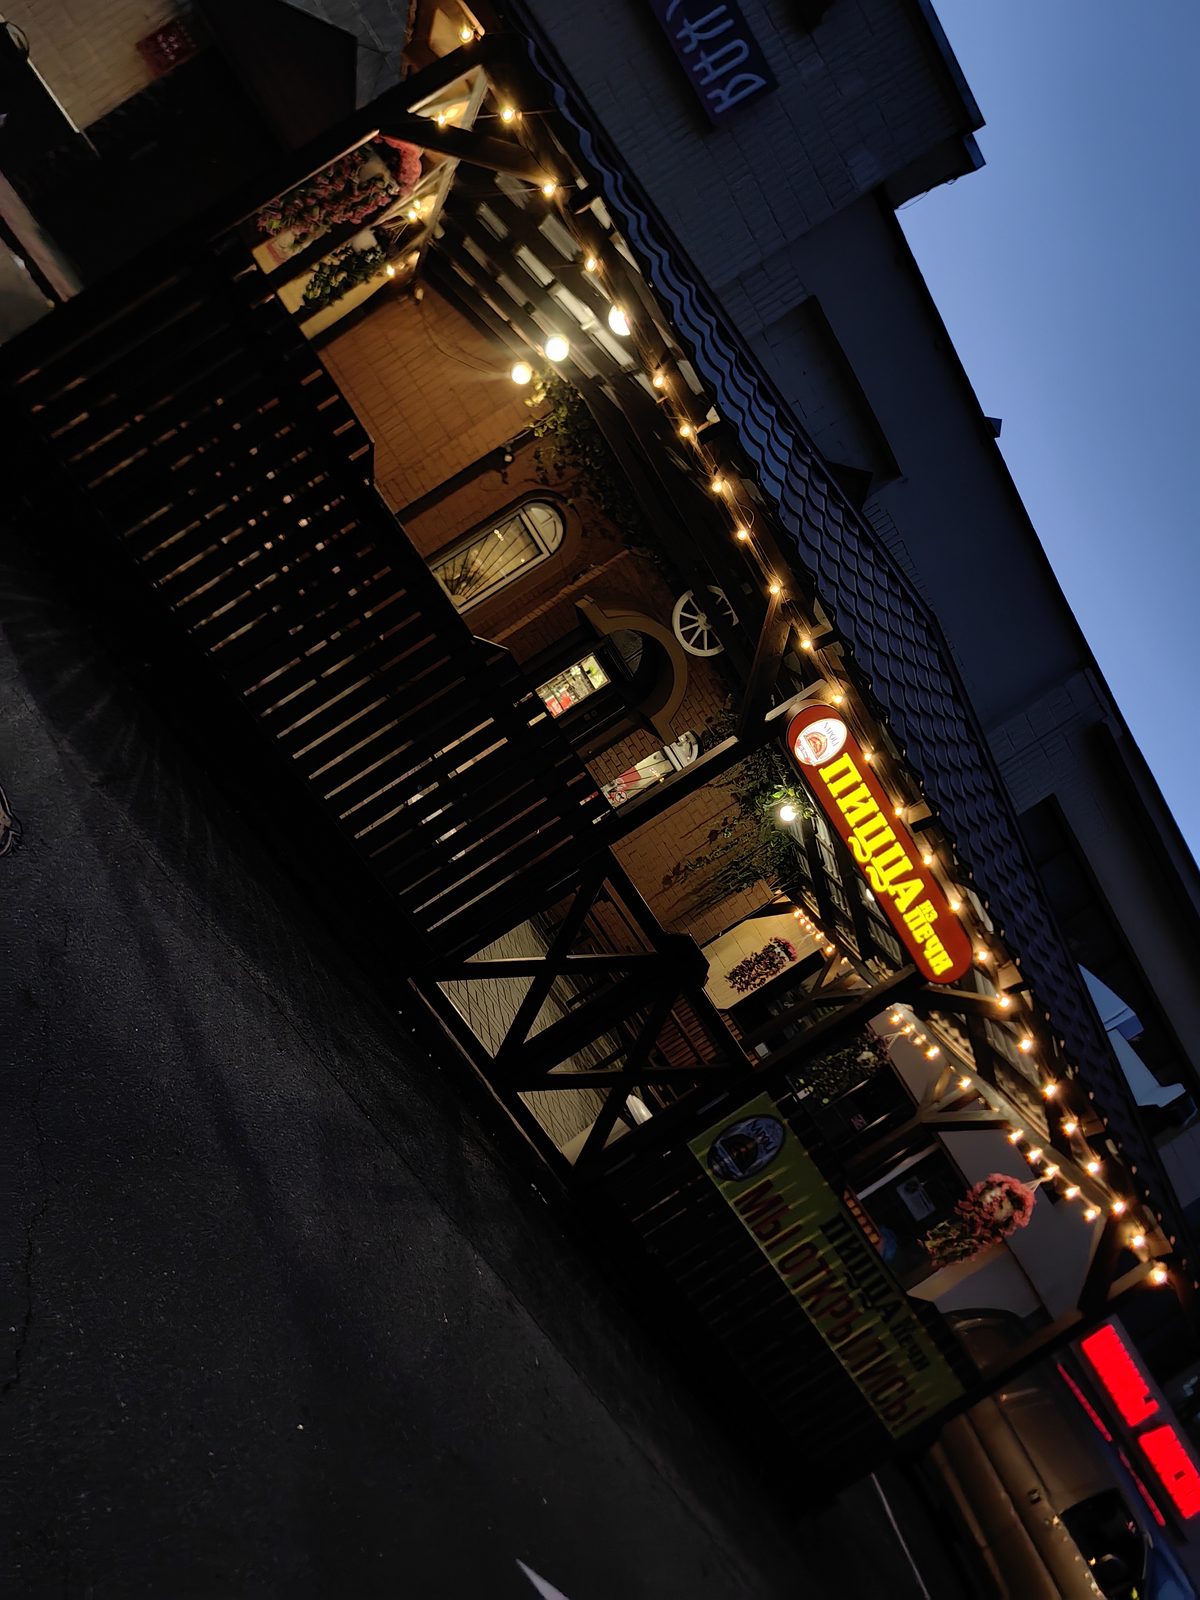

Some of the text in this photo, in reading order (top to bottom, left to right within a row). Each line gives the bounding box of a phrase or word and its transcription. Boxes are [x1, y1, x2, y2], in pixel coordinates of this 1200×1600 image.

[666, 0, 768, 114] КАЯ
[818, 752, 925, 914] ПИЦЦА
[902, 906, 954, 976] ПЕЧИ
[732, 1179, 928, 1432] МЫ ОТКРЫЛИСЬ!
[819, 1212, 902, 1324] ПИЦЦА
